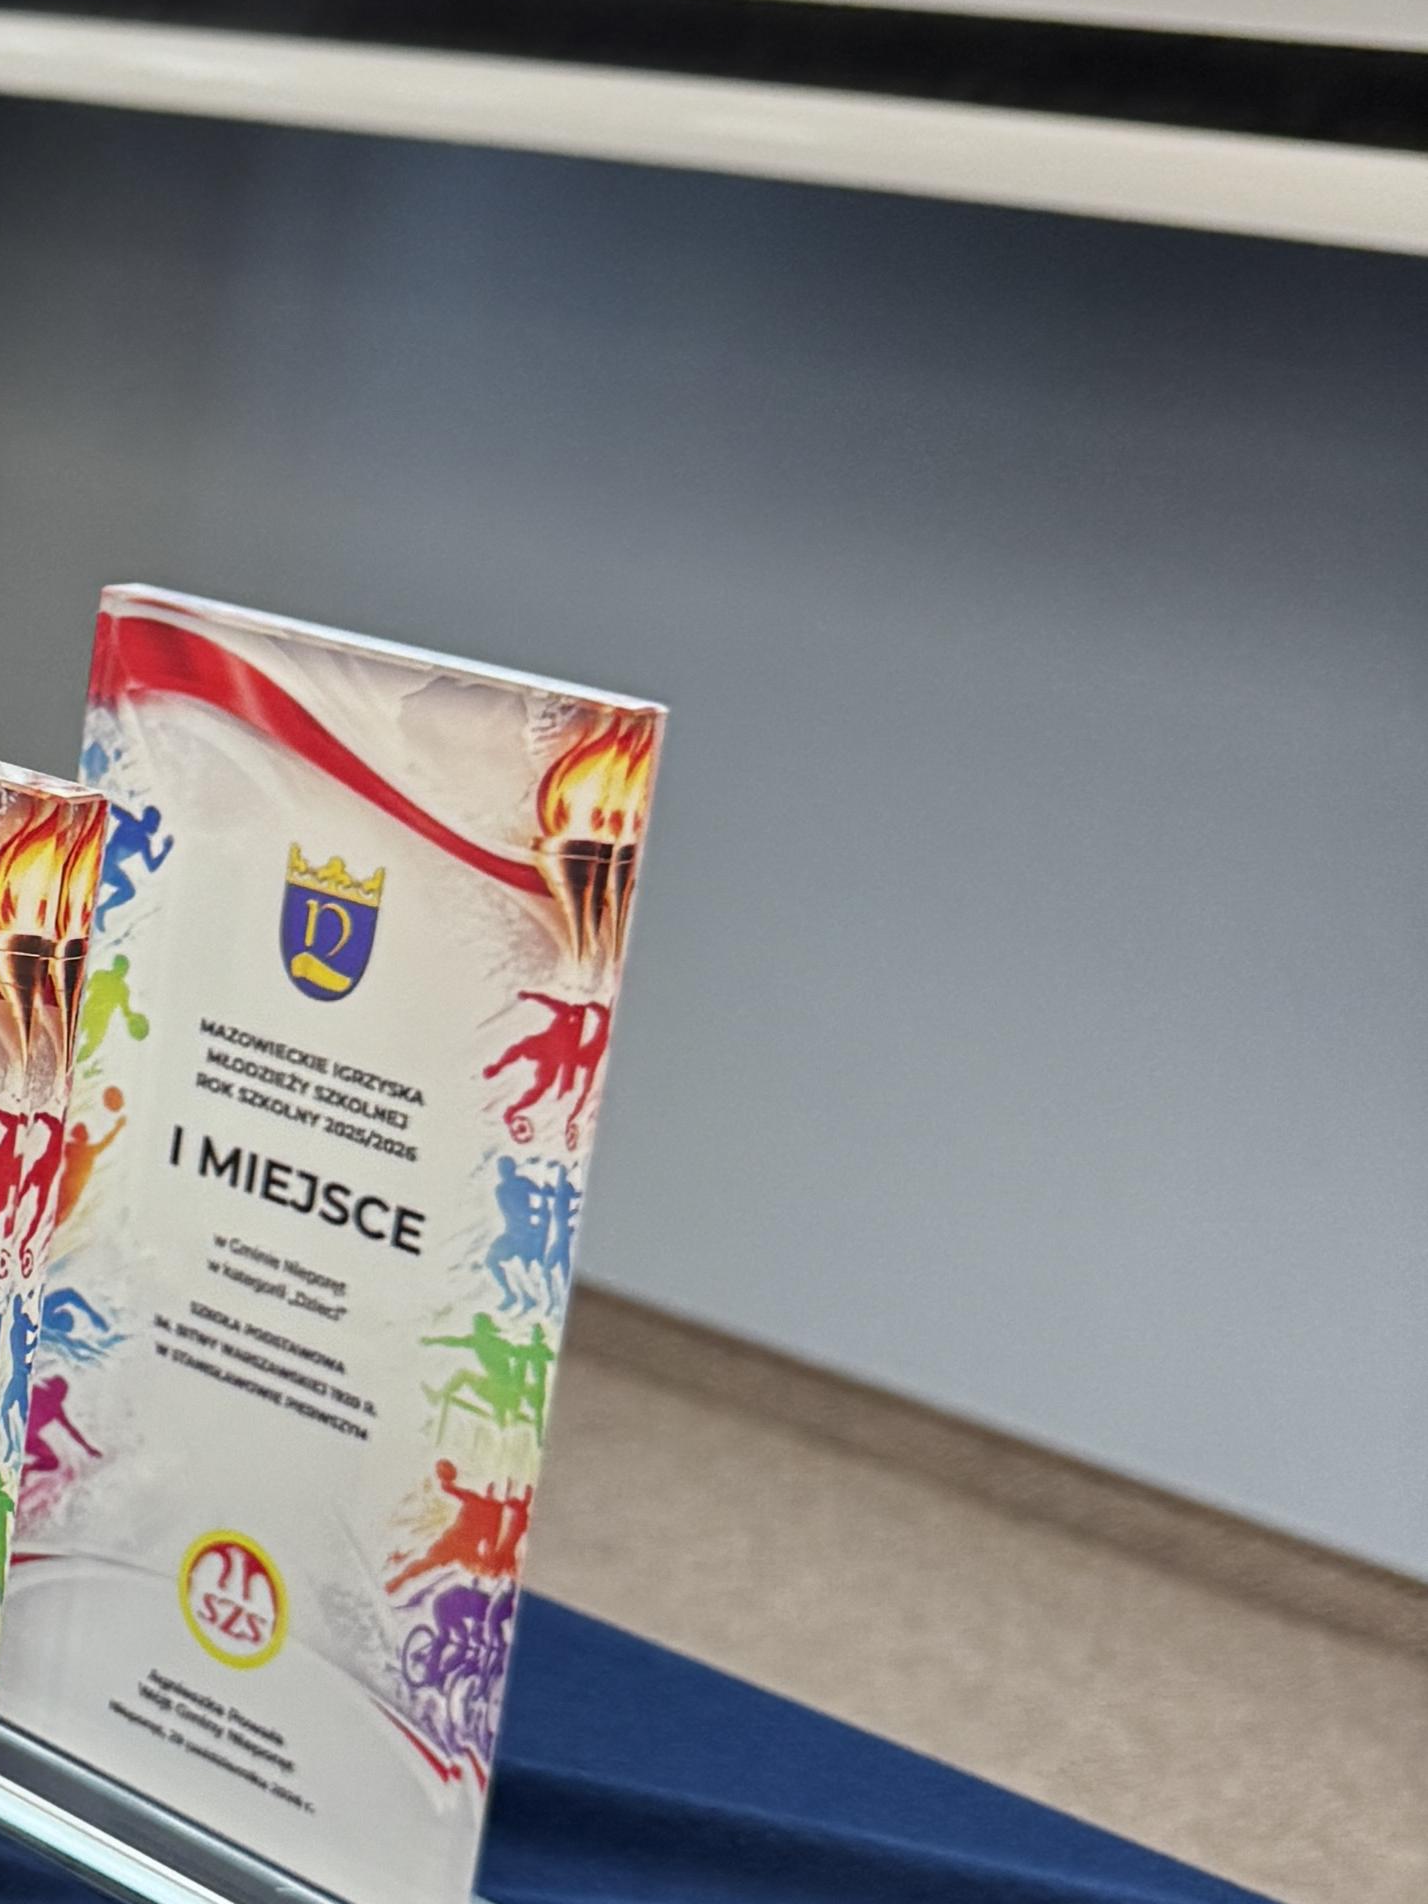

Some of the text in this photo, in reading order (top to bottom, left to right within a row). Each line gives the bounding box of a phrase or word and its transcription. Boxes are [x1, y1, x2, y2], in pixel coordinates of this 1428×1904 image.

[199, 1019, 425, 1106] MAZOWIECKIE IGRZYSKA
[195, 1073, 234, 1098] ROK
[237, 1087, 321, 1126] SZKOLNY
[313, 1086, 409, 1130] SZKOLNEJ
[169, 1126, 426, 1255] I MIEJSCE
